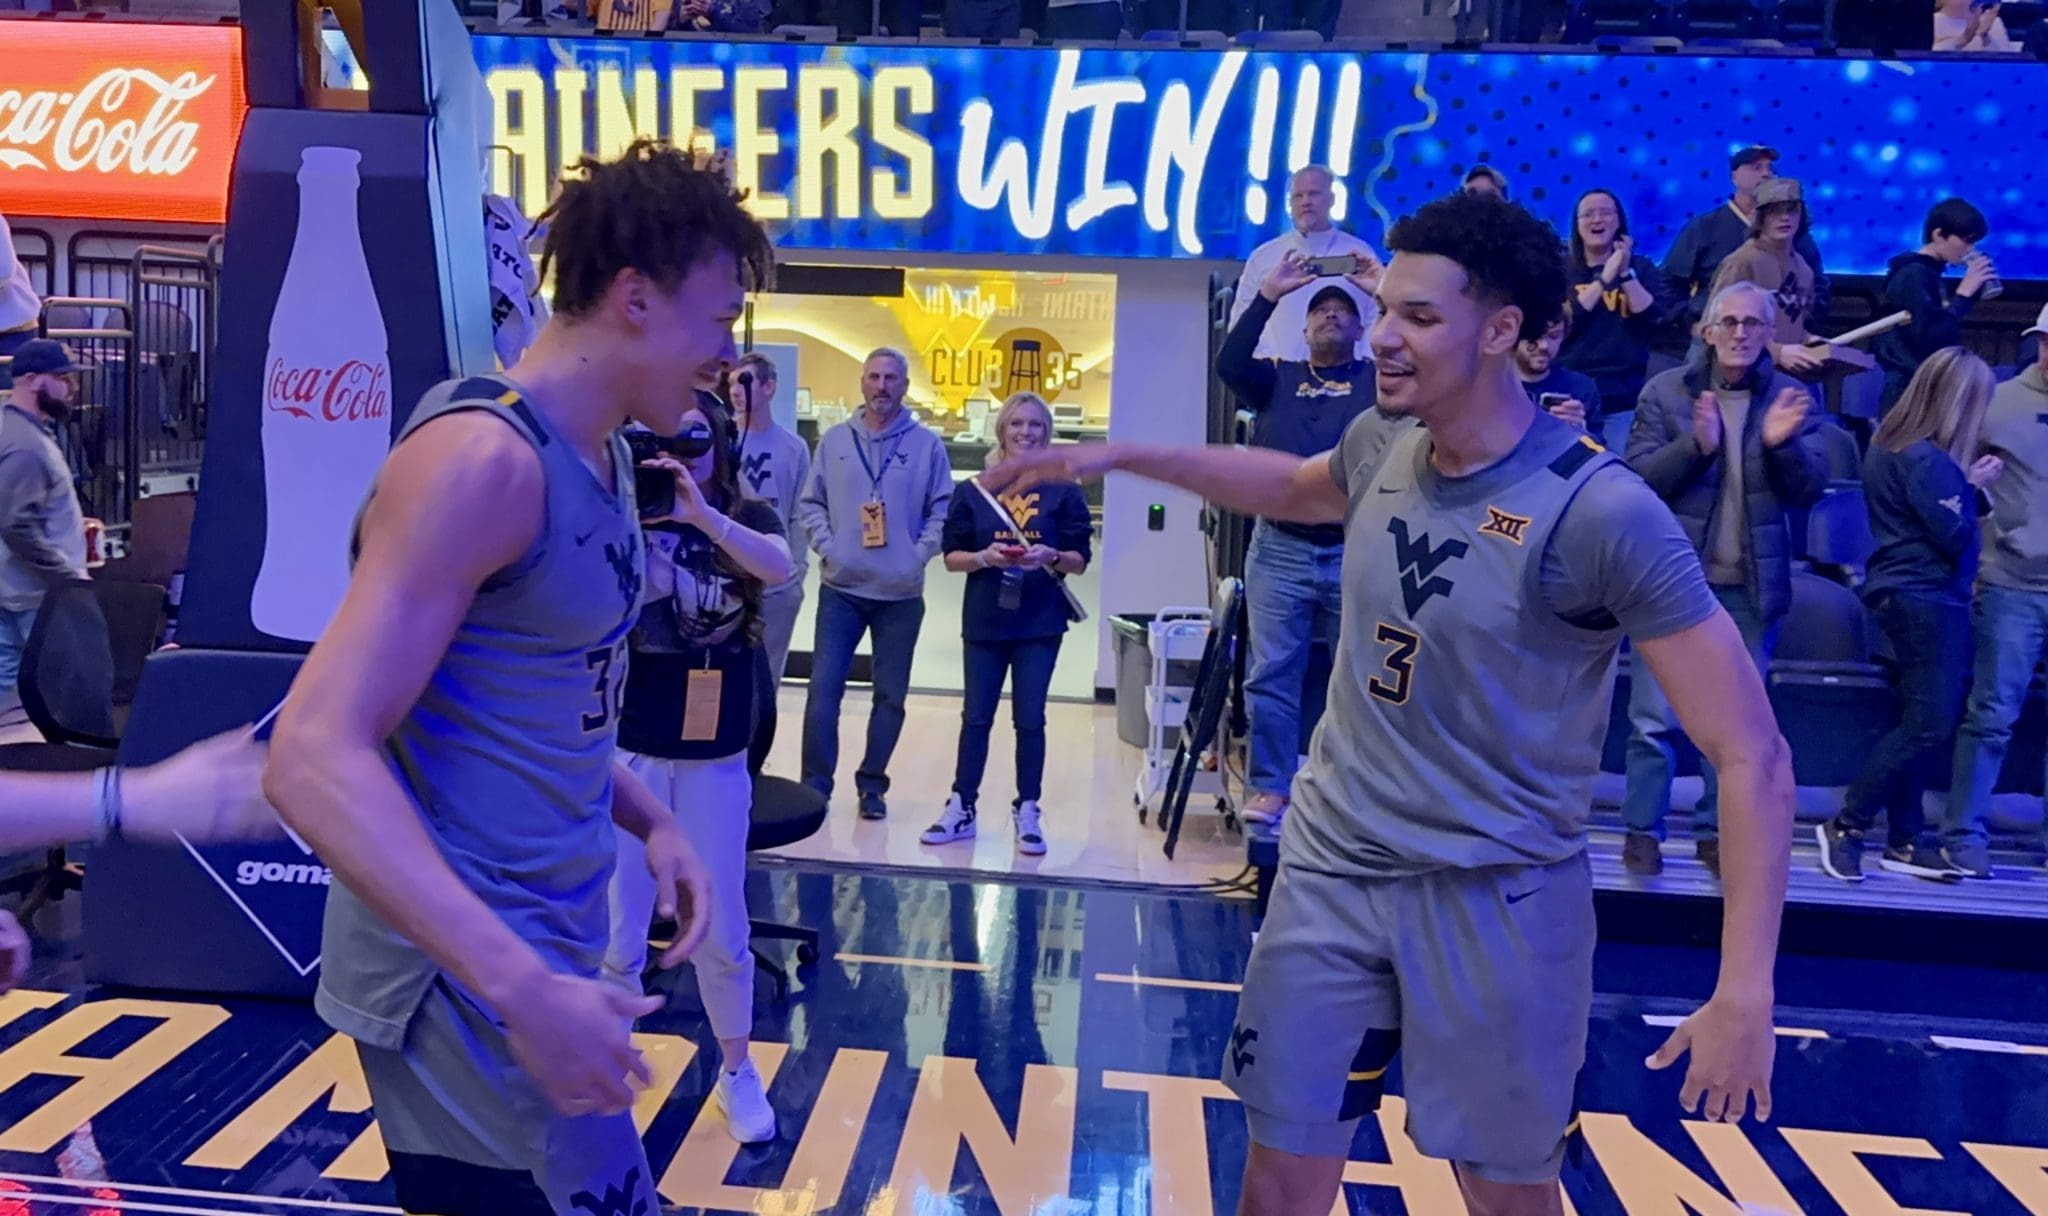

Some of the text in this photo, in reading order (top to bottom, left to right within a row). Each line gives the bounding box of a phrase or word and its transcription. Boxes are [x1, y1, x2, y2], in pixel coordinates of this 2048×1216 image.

[267, 357, 386, 422] Coca-Cola
[931, 348, 1084, 391] CLUB 35
[1368, 621, 1421, 706] 3
